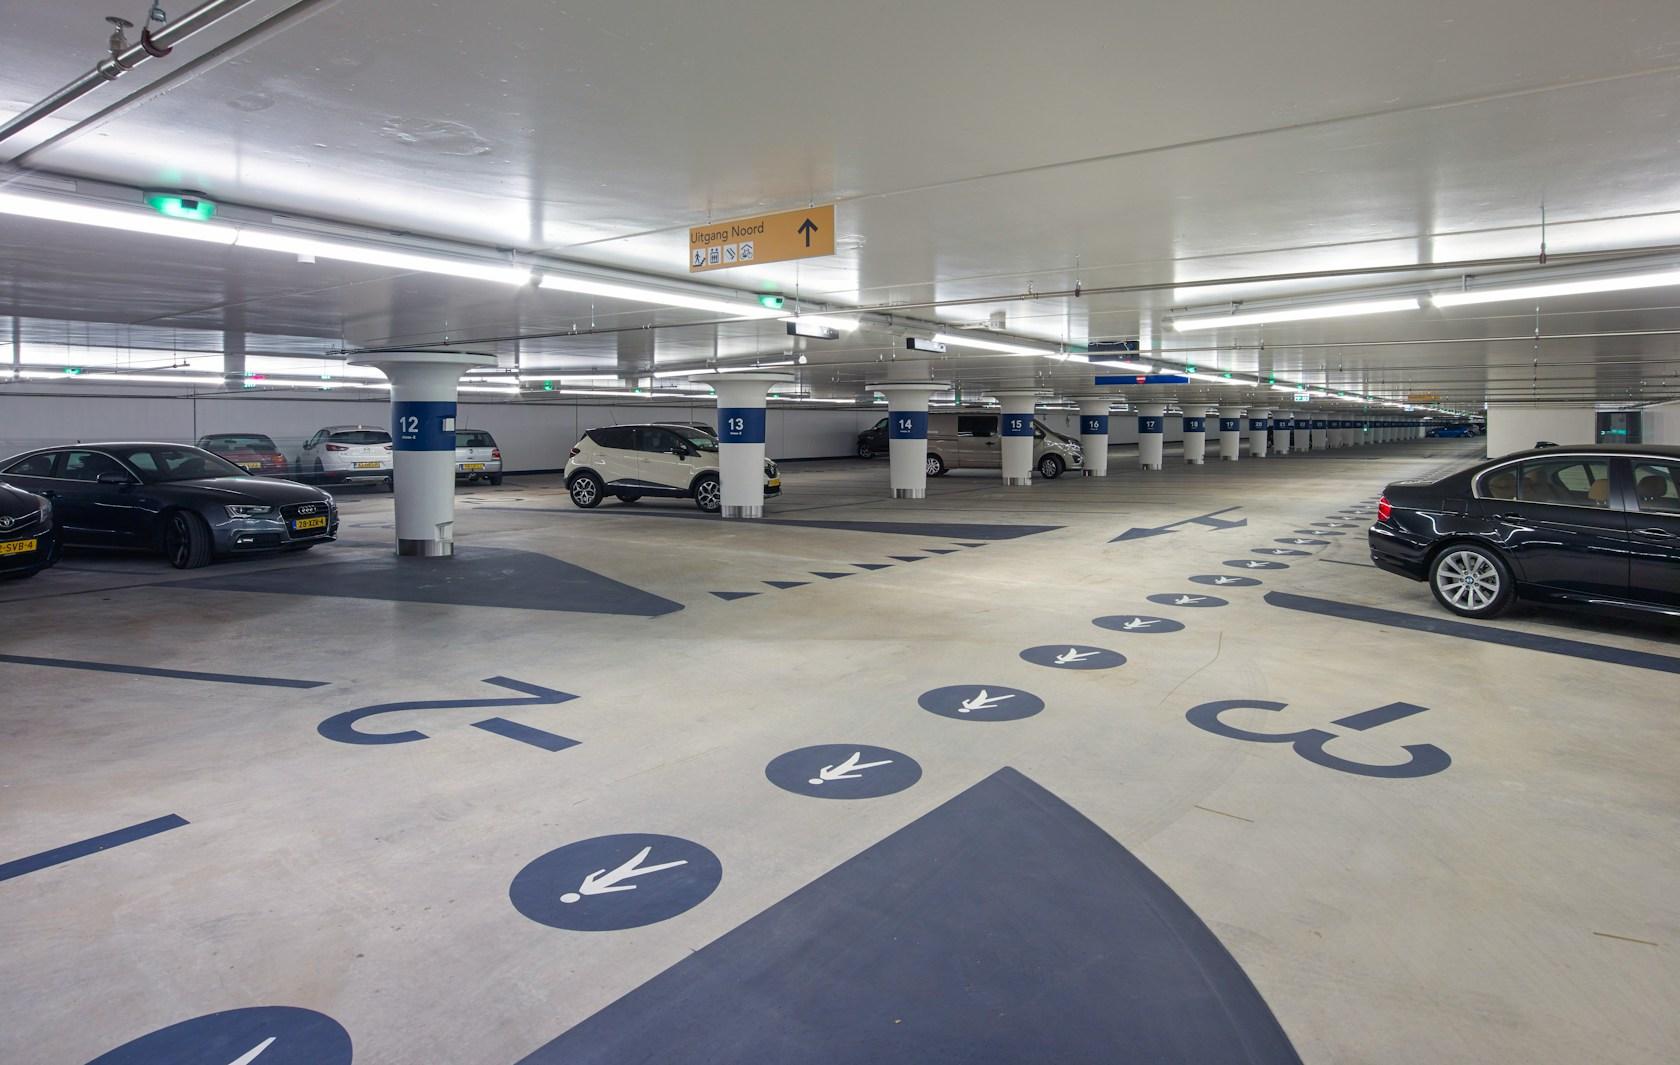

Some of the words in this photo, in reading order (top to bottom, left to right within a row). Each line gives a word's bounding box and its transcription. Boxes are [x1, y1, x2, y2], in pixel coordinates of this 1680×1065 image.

[691, 230, 729, 245] Uitgang
[731, 221, 764, 237] Noord
[399, 416, 419, 433] 12
[728, 417, 744, 431] 13
[898, 418, 913, 430] 14
[1010, 419, 1023, 429] 15
[1088, 420, 1100, 429] 16
[1145, 420, 1155, 428] 17
